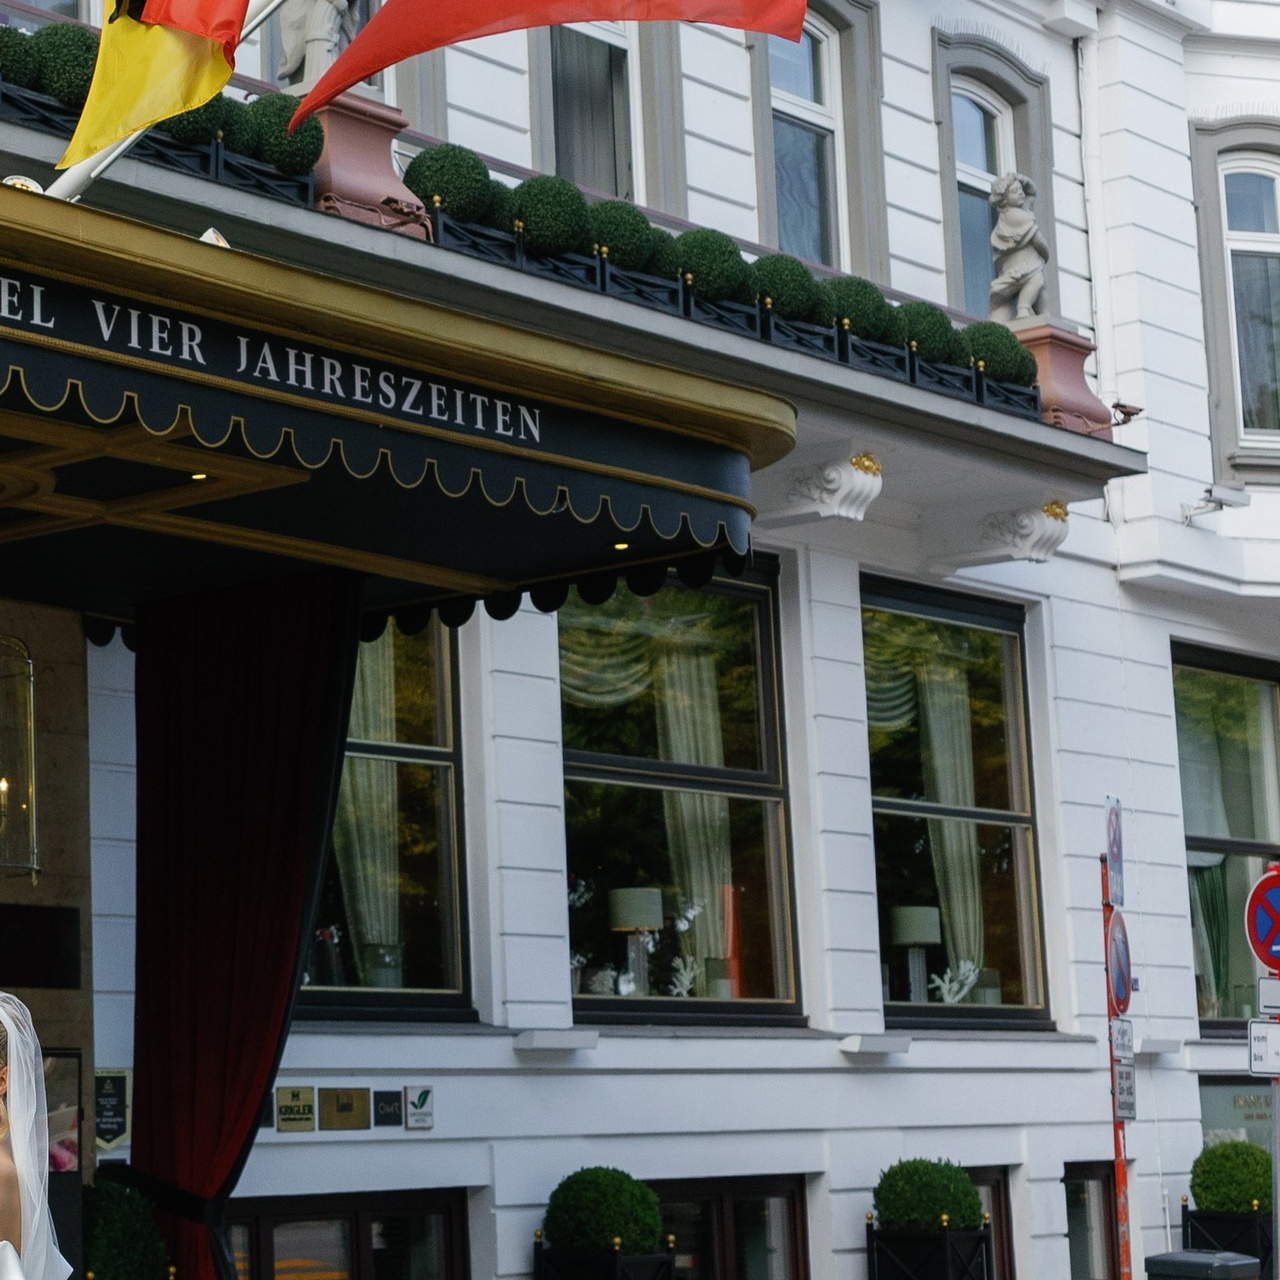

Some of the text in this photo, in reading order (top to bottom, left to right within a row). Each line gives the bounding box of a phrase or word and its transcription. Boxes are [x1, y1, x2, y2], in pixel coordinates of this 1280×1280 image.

[92, 299, 205, 366] VIER
[236, 336, 542, 444] JAHRESZEITEN
[1253, 1034, 1268, 1043] vom
[1253, 1051, 1264, 1062] bis
[278, 1104, 314, 1116] KRIGLER
